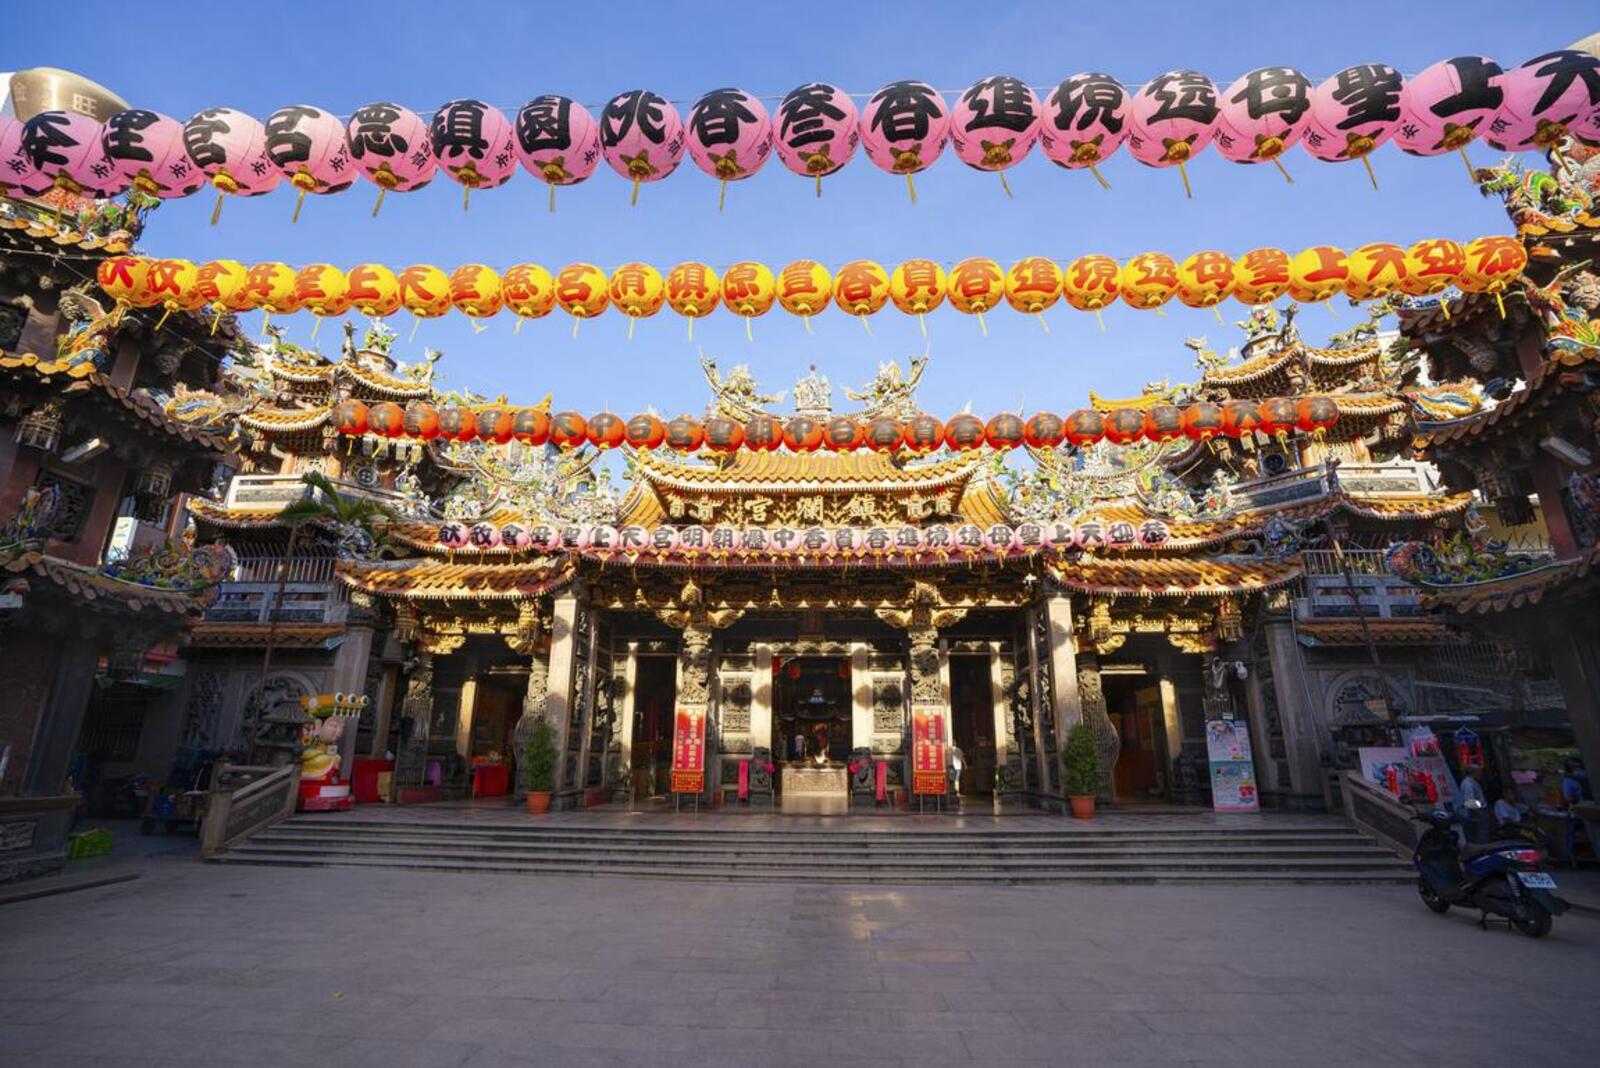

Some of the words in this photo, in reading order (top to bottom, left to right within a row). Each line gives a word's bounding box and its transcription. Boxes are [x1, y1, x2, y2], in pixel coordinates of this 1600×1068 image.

[963, 76, 1038, 133] 進
[1231, 66, 1312, 125] 母
[1332, 64, 1403, 130] 聖
[1430, 56, 1504, 118] 上
[690, 88, 758, 147] 香
[871, 81, 943, 142] 香
[951, 258, 1001, 297] 香
[1014, 258, 1060, 293] 進
[1186, 251, 1236, 289] 母
[1303, 247, 1350, 282] 上
[1359, 243, 1407, 282] 天
[836, 260, 883, 301] 香
[592, 527, 610, 548] 上
[622, 527, 643, 547] 天
[682, 529, 703, 547] 明
[773, 529, 795, 548] 中
[804, 528, 827, 549] 香
[866, 528, 890, 549] 香
[896, 528, 919, 547] 進
[988, 526, 1013, 544] 母
[1020, 524, 1041, 546] 聖
[1050, 525, 1072, 543] 上
[1080, 524, 1103, 543] 天
